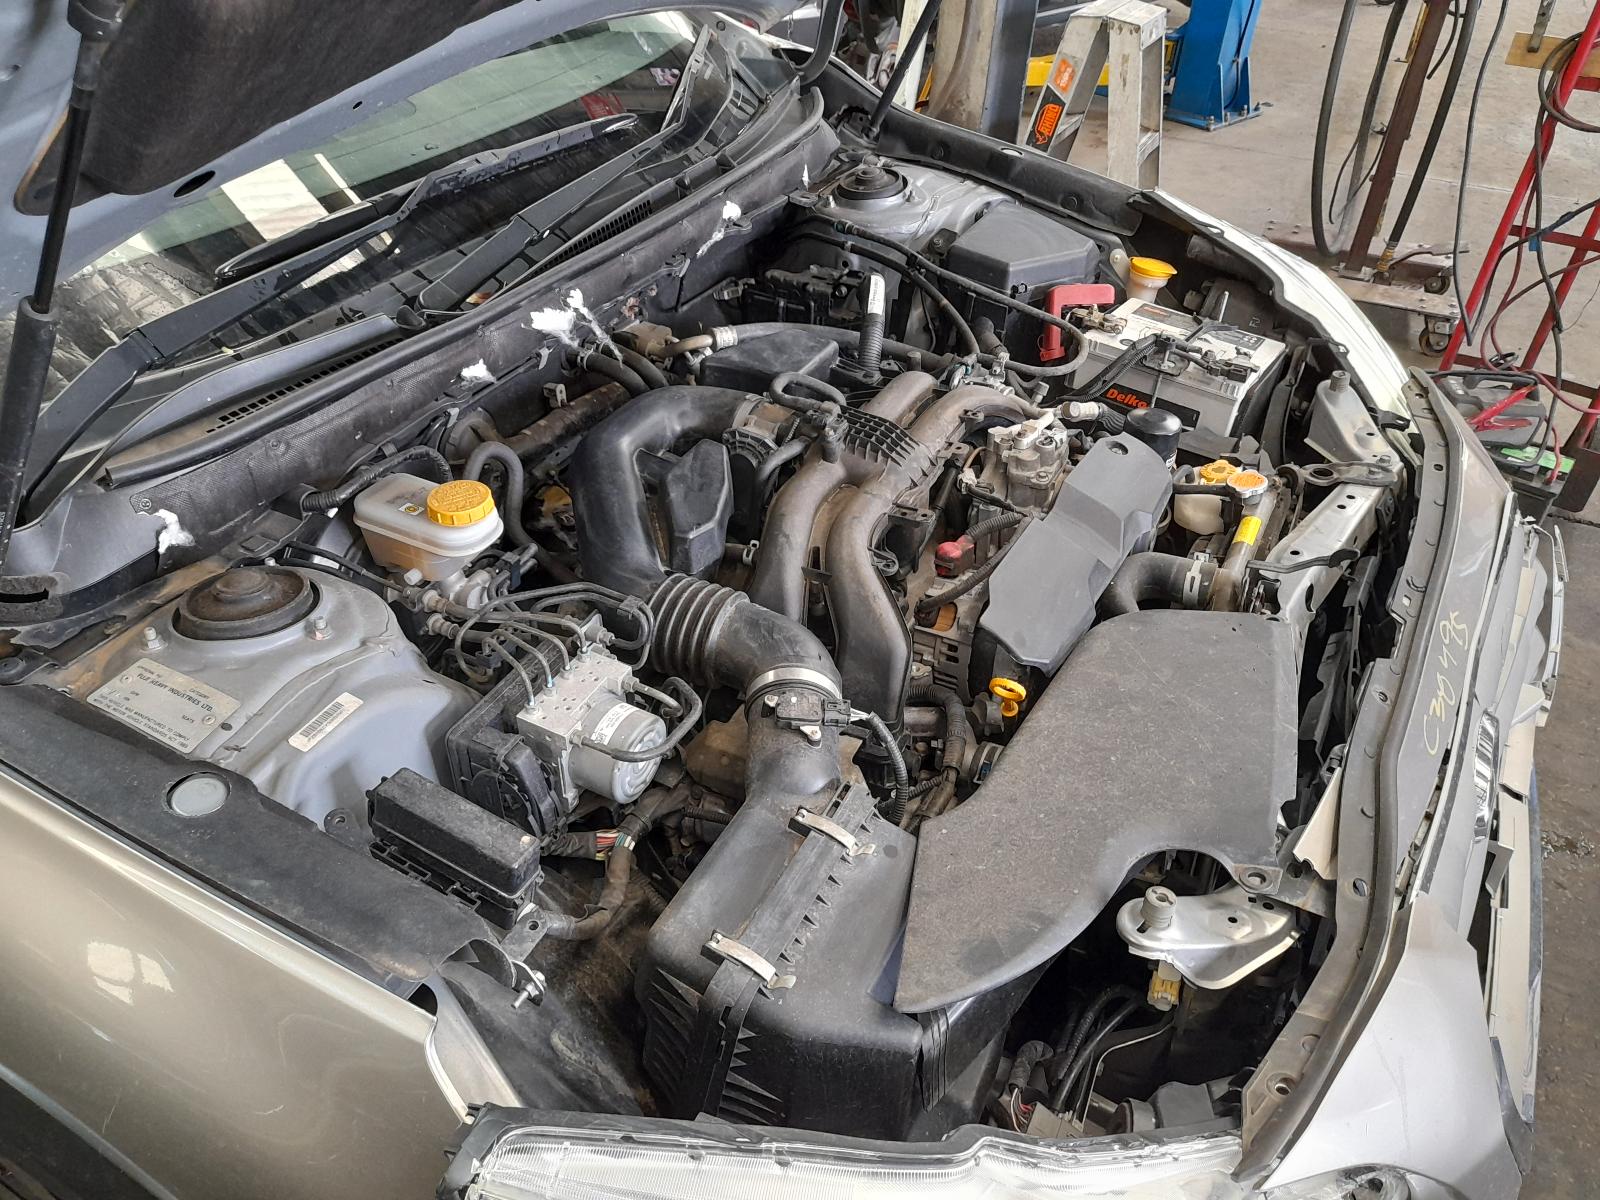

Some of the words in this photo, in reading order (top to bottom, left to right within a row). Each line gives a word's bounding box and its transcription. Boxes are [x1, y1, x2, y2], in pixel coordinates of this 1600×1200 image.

[1041, 104, 1060, 136] RHINO
[137, 673, 151, 681] FUJI
[150, 678, 168, 690] HEAVY
[167, 686, 201, 706] INDUSTRIES
[201, 702, 214, 713] LTD.
